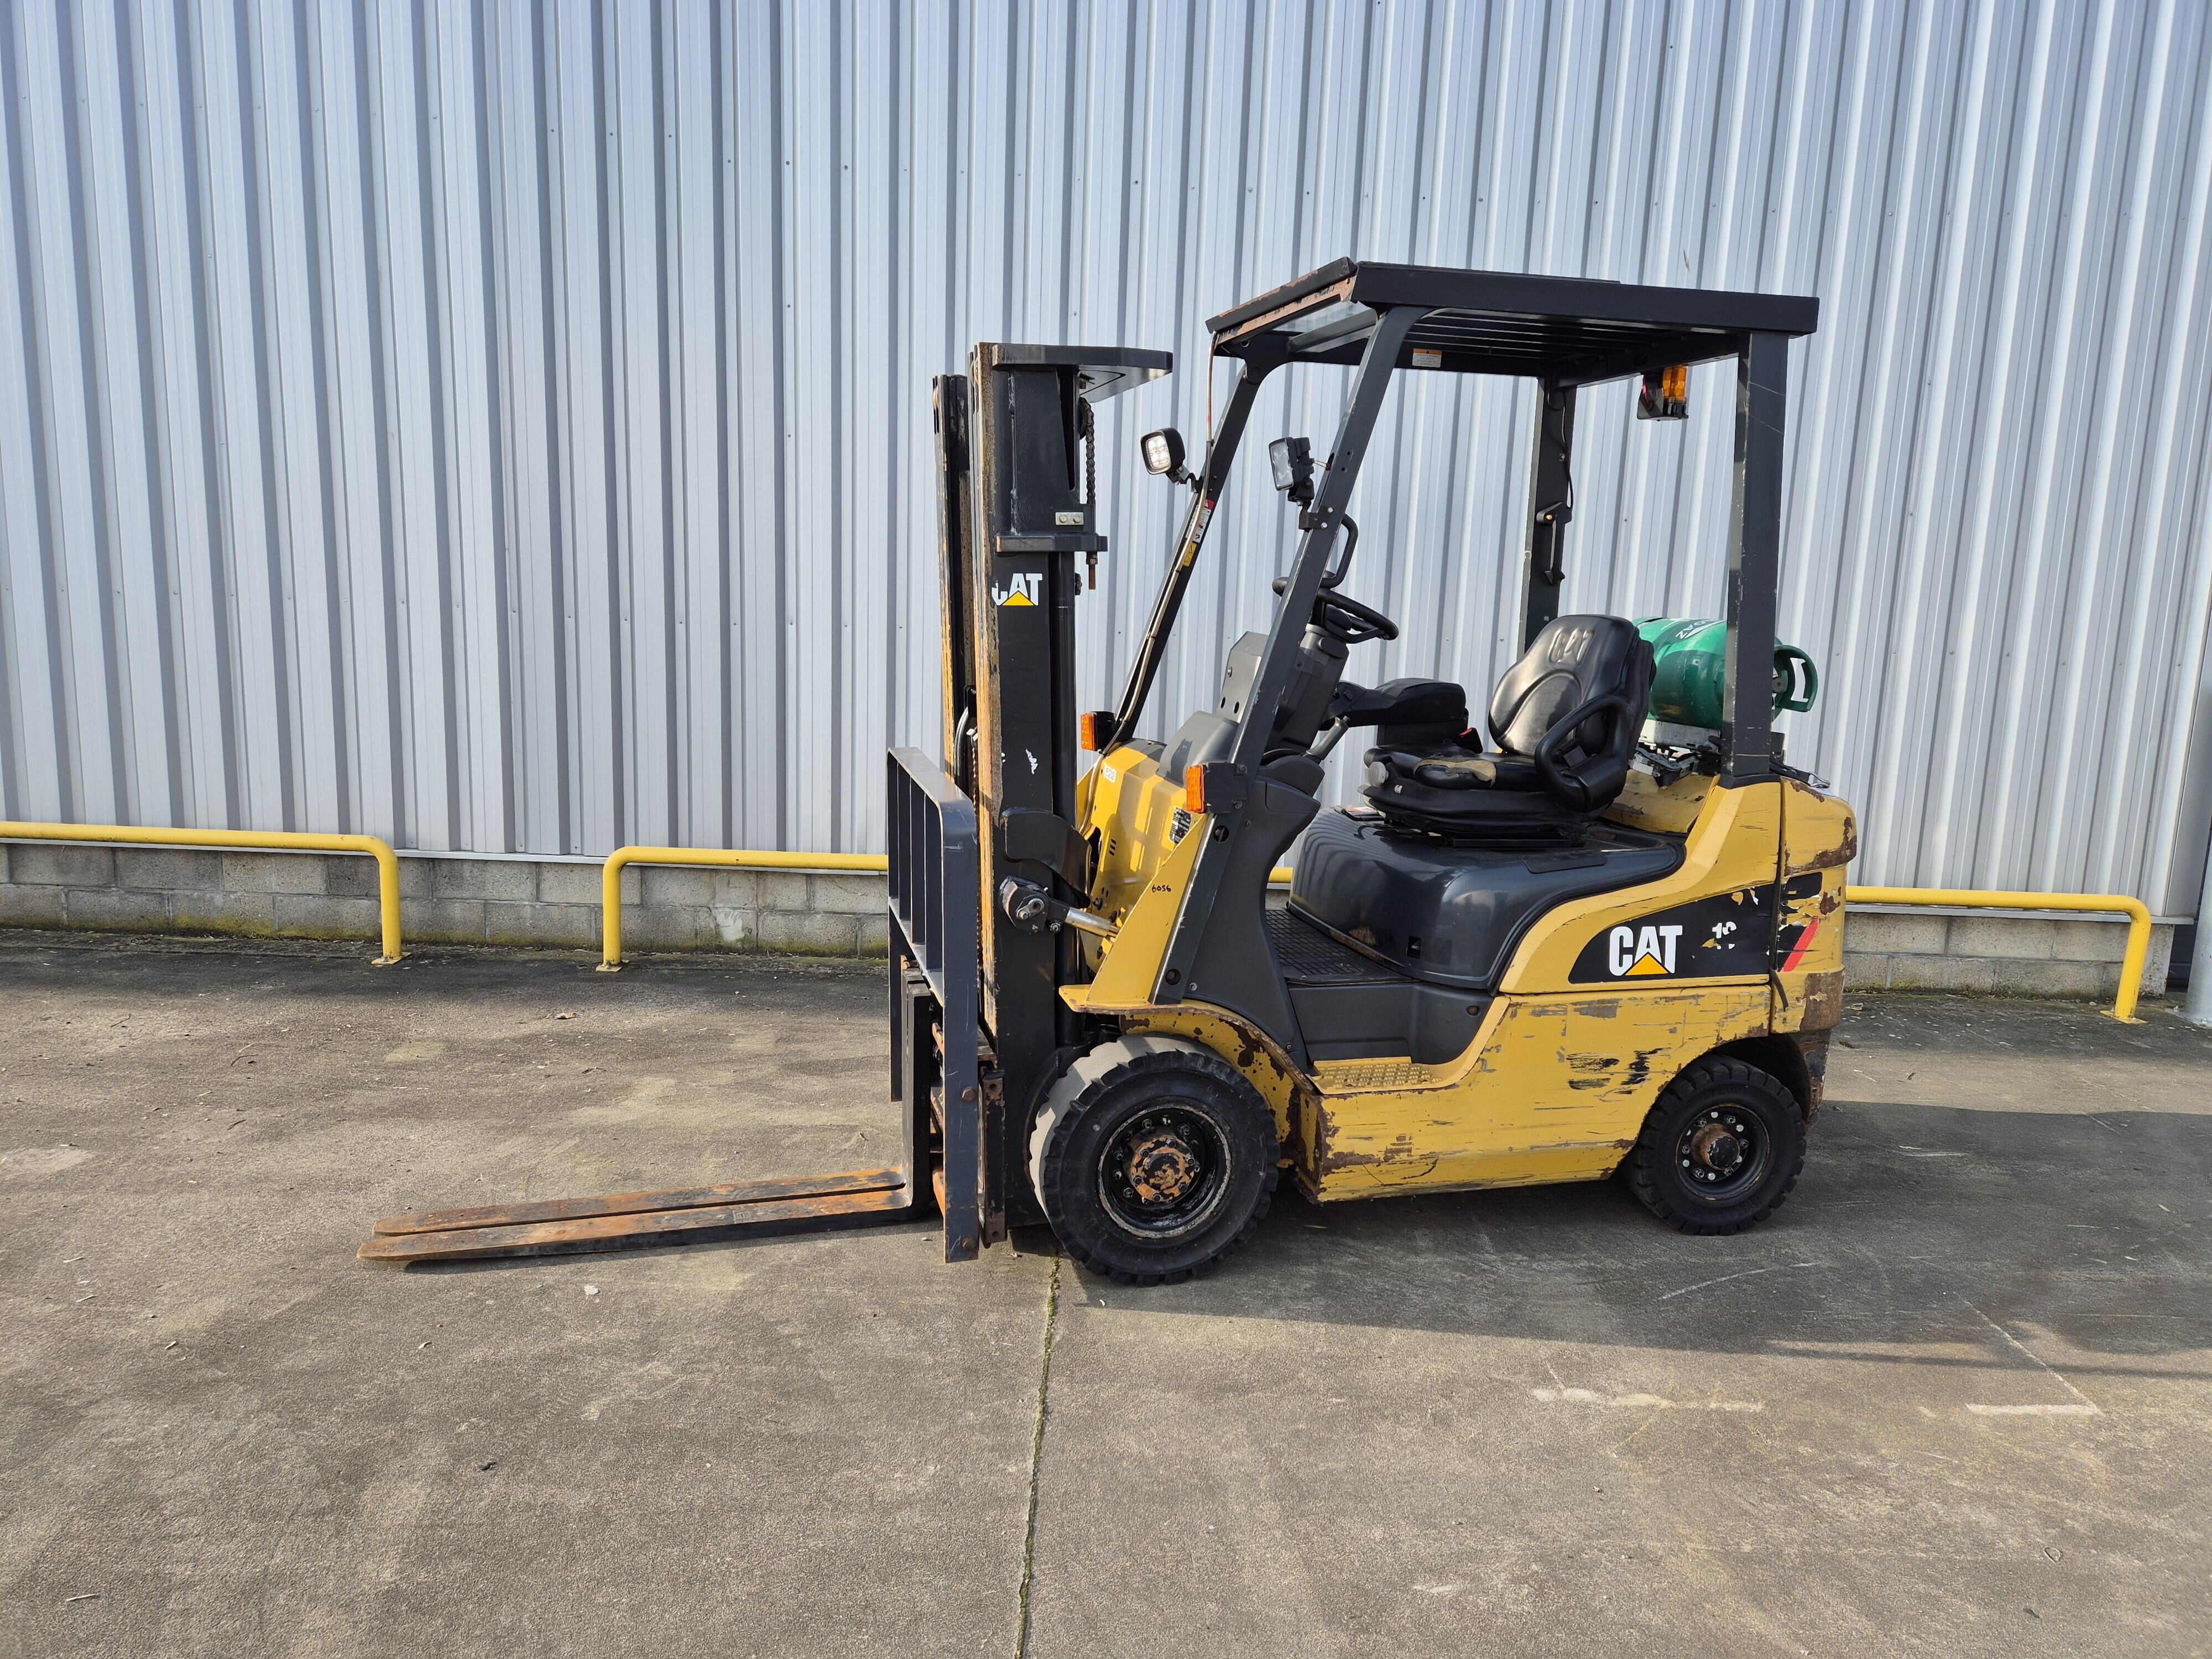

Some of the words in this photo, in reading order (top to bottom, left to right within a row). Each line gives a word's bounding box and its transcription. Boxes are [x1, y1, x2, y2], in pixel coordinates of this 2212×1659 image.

[1548, 627, 1595, 665] CAT
[1151, 884, 1172, 893] 6056
[1609, 925, 1683, 976] CAT
